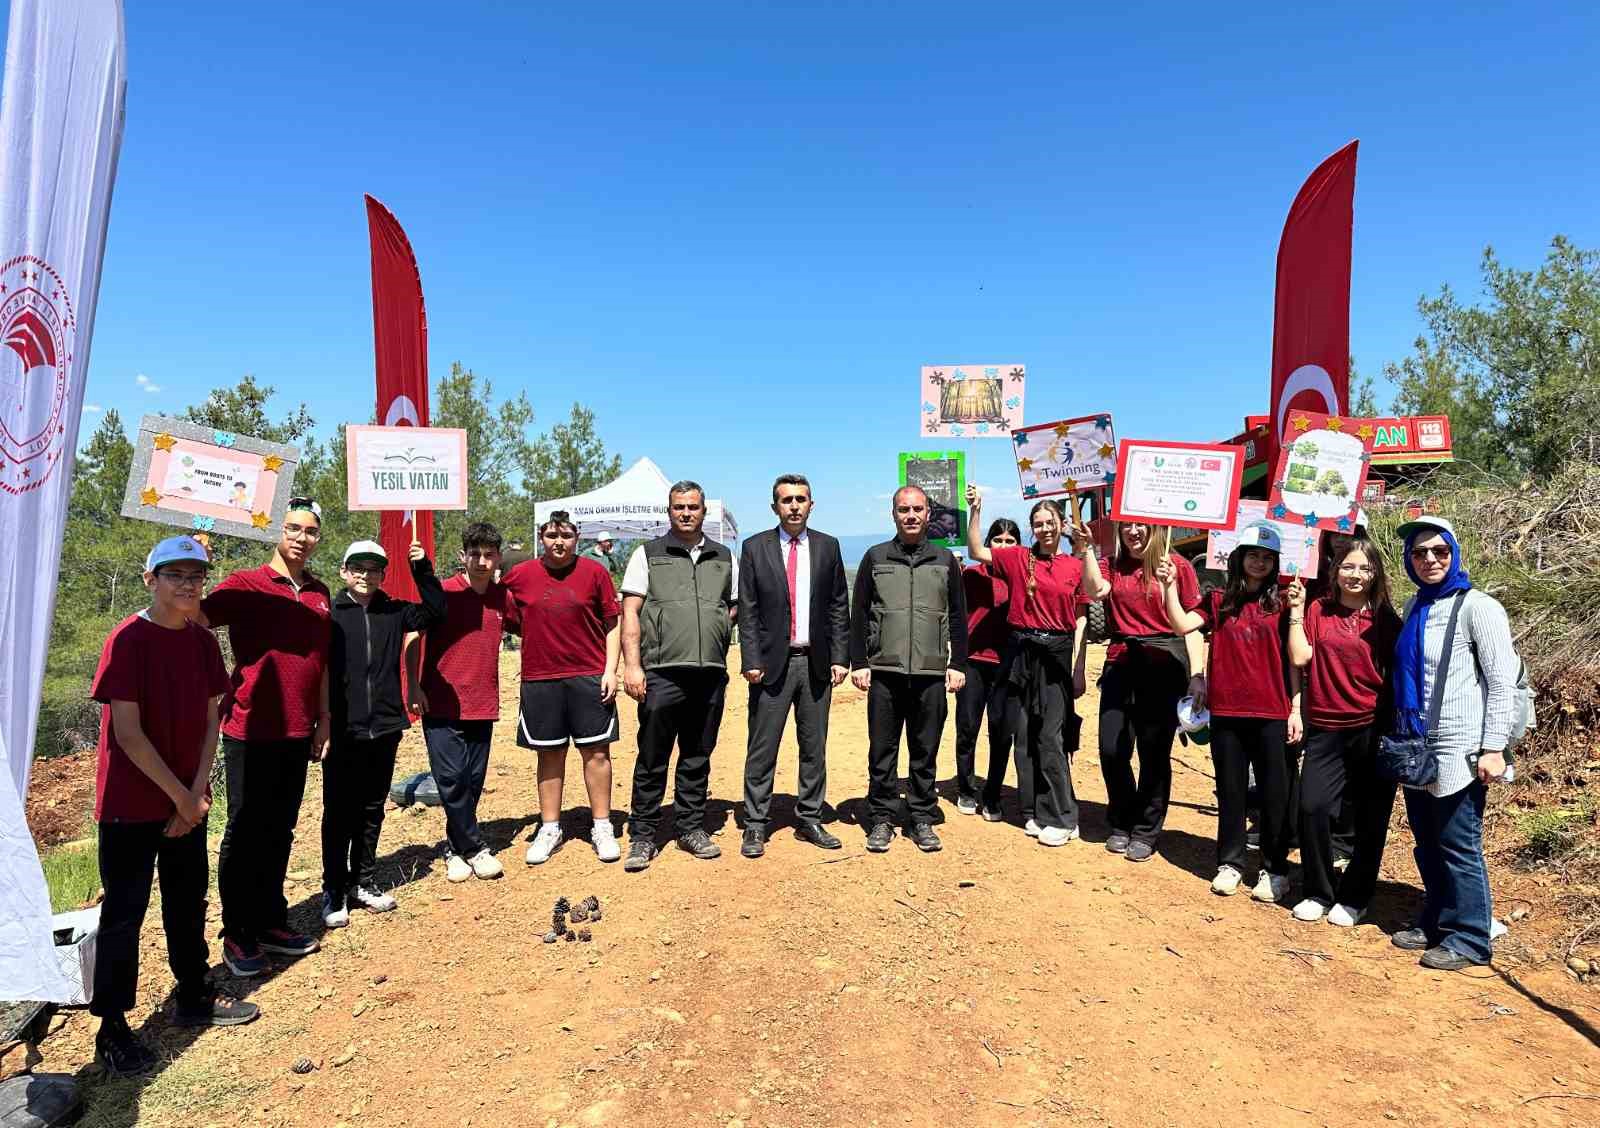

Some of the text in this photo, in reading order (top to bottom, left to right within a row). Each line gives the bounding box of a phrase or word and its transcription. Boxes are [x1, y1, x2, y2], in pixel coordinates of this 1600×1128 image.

[1421, 423, 1441, 434] 112
[1042, 461, 1102, 480] Twinning
[409, 472, 448, 490] VATAN
